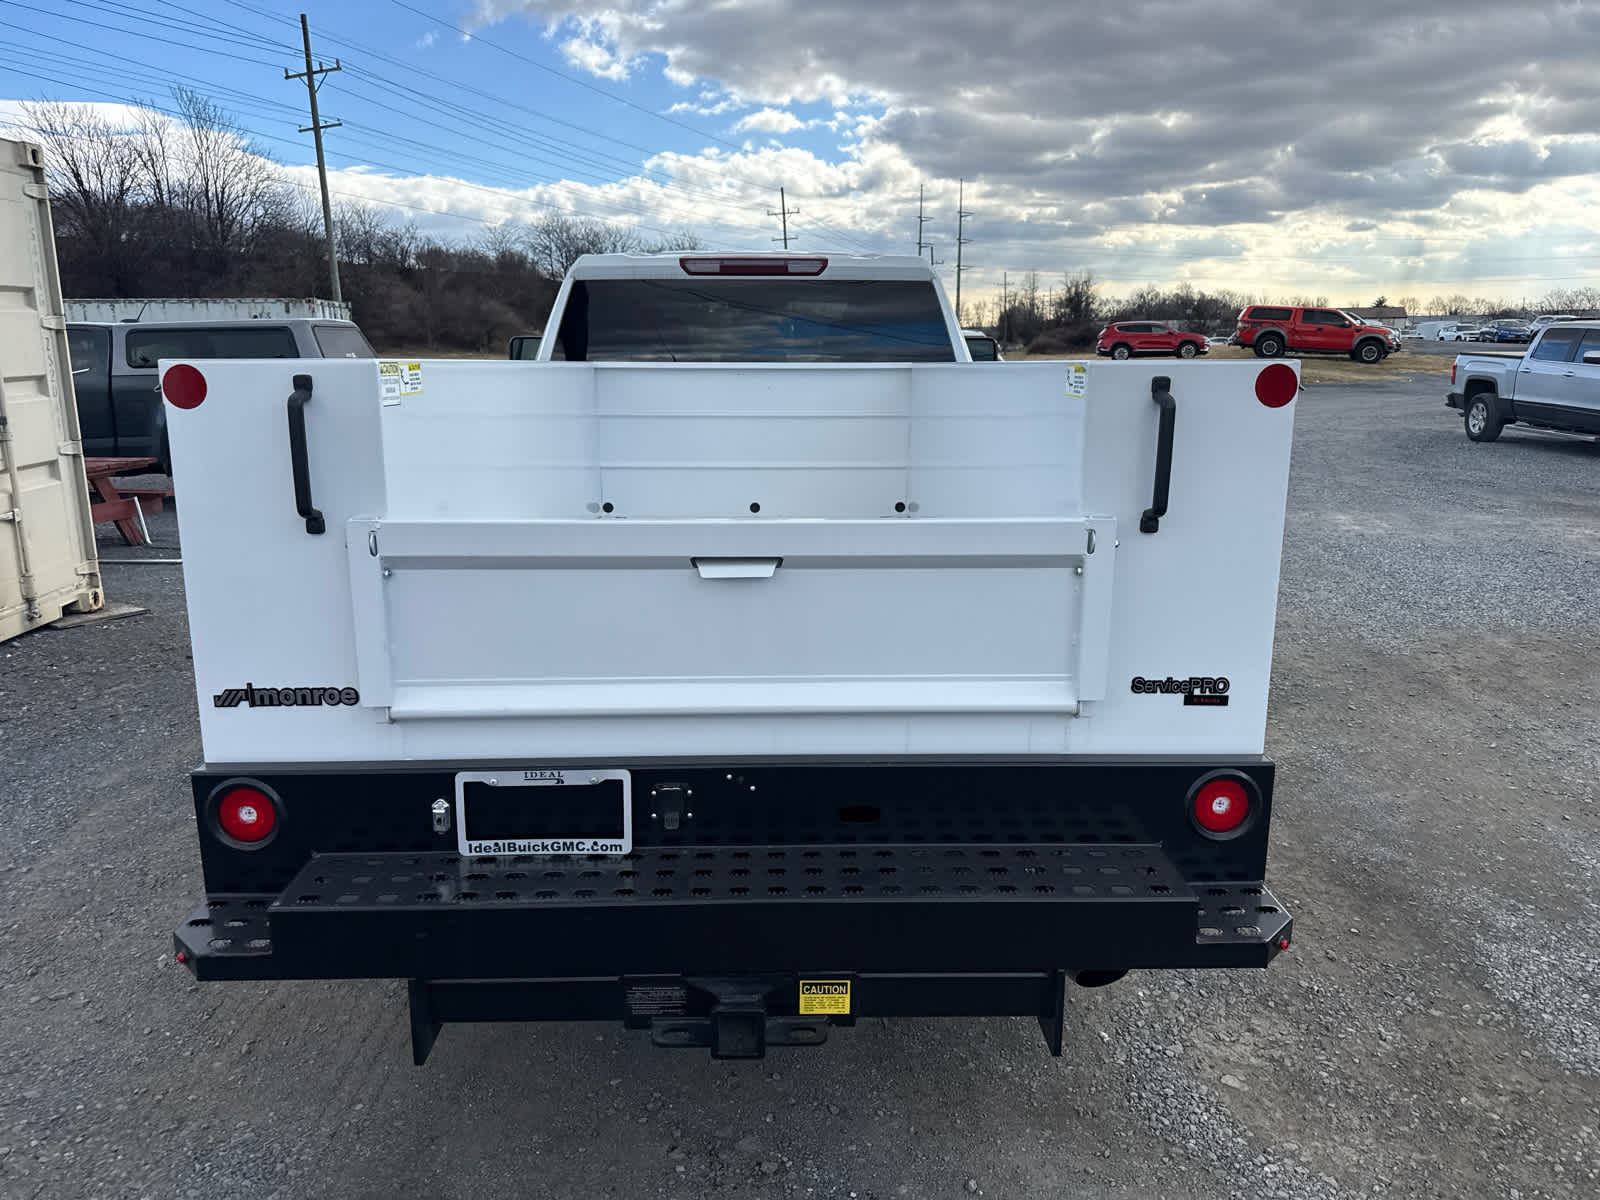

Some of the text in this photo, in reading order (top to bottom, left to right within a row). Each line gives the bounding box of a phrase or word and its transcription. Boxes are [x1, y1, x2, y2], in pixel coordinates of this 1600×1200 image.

[1131, 676, 1230, 694] ServicePRO
[253, 686, 360, 707] monroe
[523, 770, 564, 779] IDEAL
[467, 840, 623, 854] IdealBuickGMC.com
[803, 984, 847, 994] CAUTION
